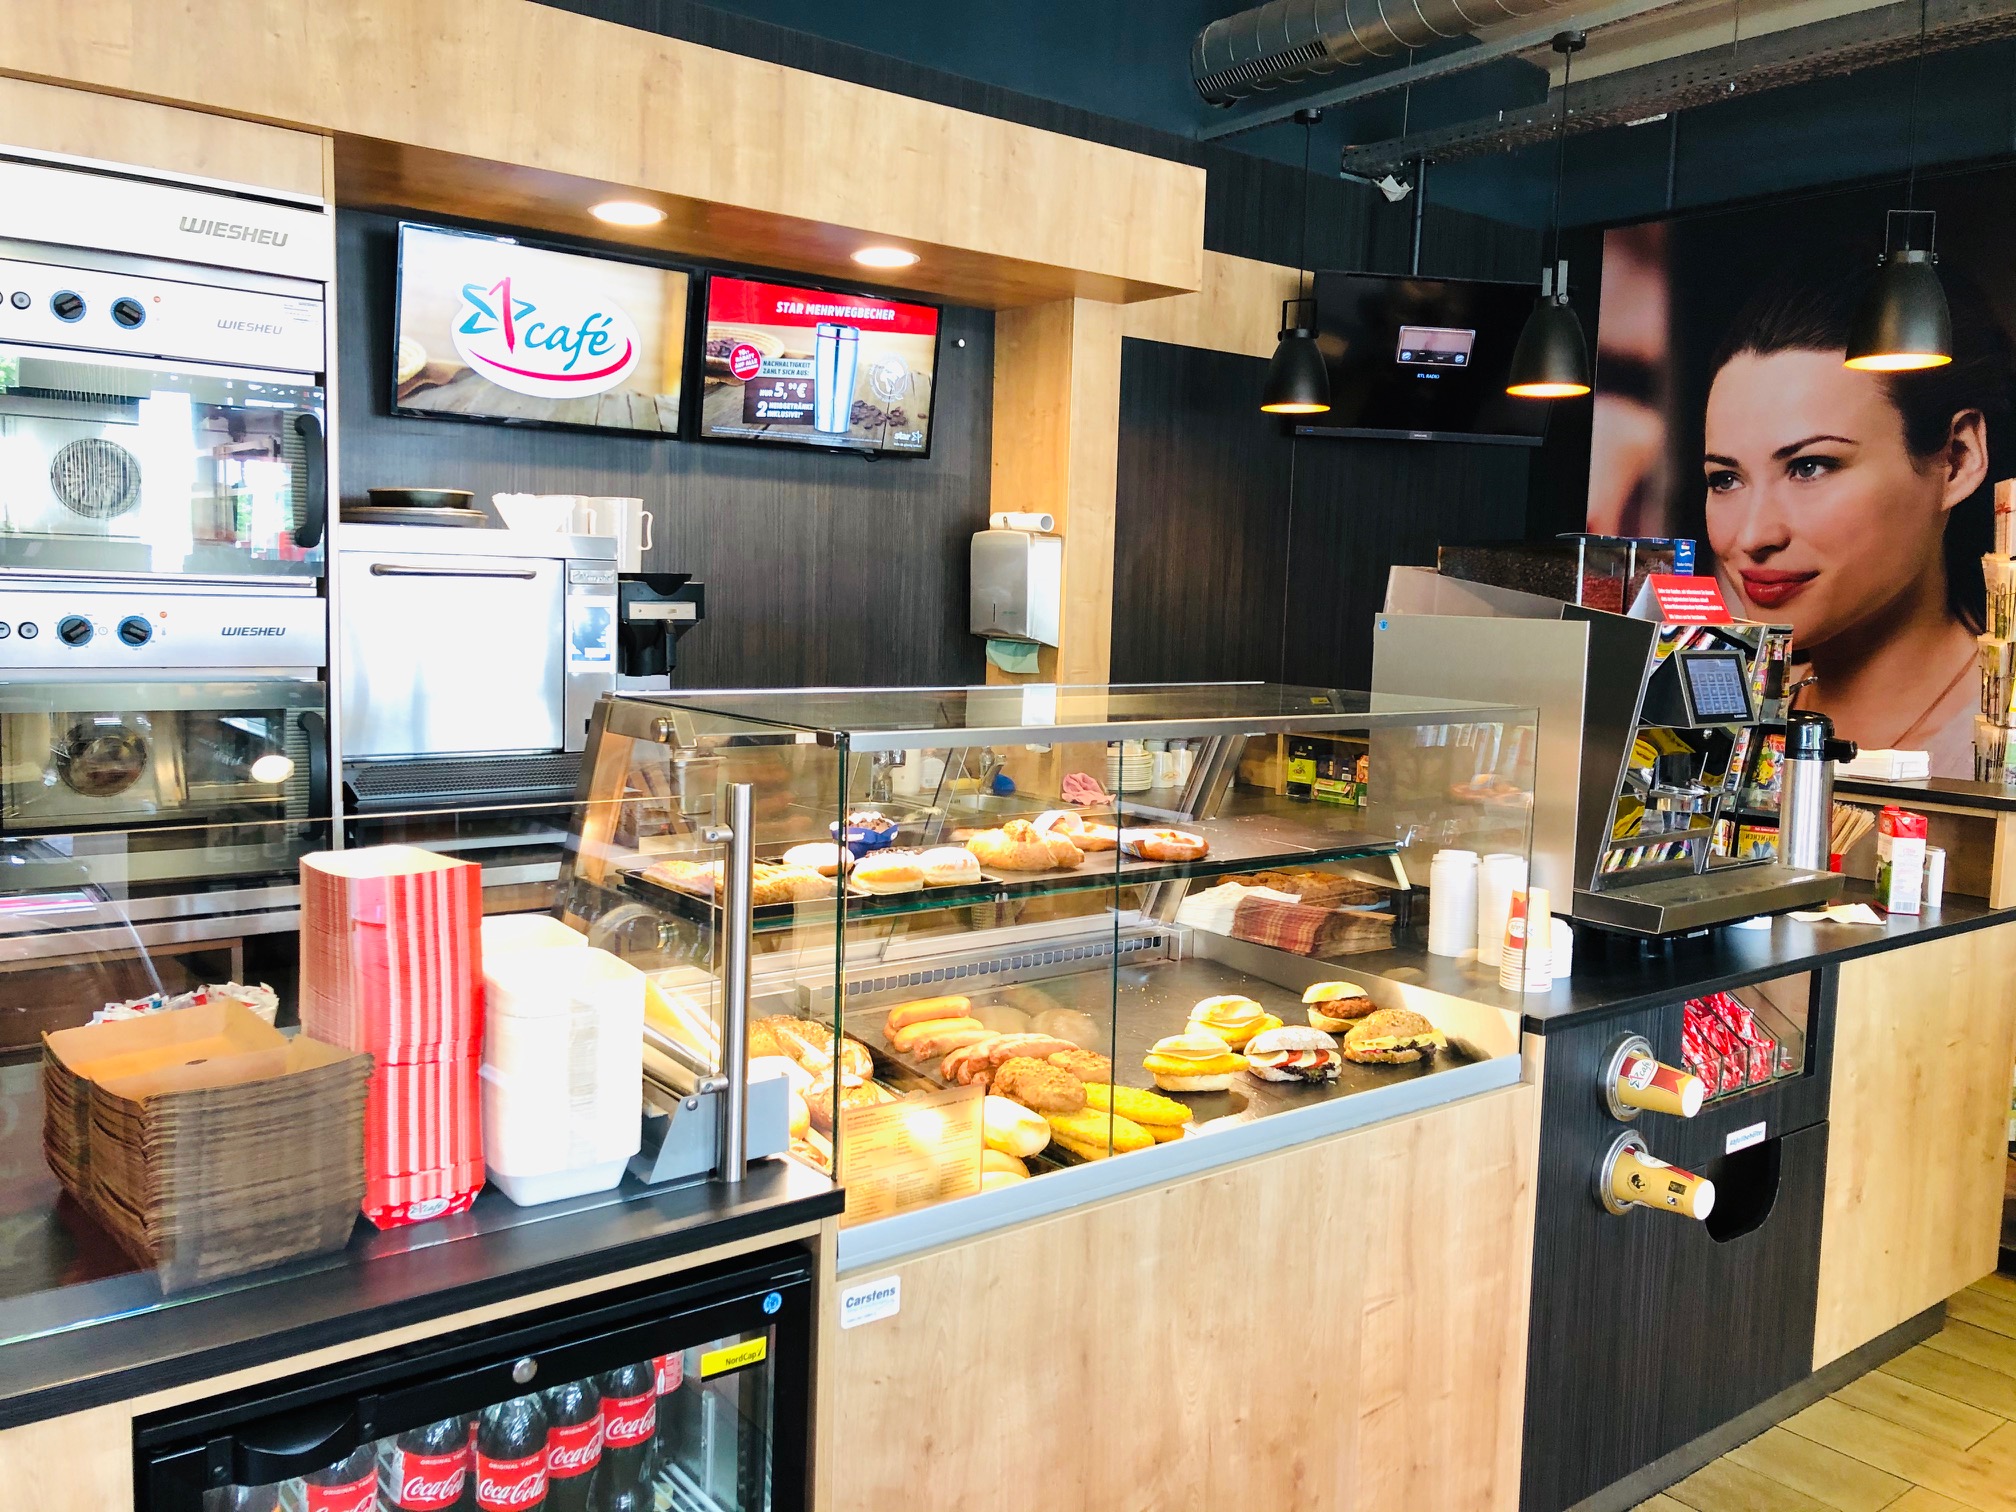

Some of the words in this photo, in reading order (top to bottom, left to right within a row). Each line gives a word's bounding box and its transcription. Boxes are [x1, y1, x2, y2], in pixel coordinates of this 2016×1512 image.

[179, 216, 288, 247] WIESHEU
[776, 301, 804, 315] STAR
[805, 303, 896, 320] MEHRWEGBECHER
[217, 319, 283, 334] WIESHEU
[524, 312, 616, 371] café
[756, 401, 768, 417] 2
[221, 626, 286, 636] WIESHEU
[846, 1287, 896, 1309] Carstens
[726, 1352, 757, 1366] NordCap
[489, 1461, 519, 1470] ORIGINAL
